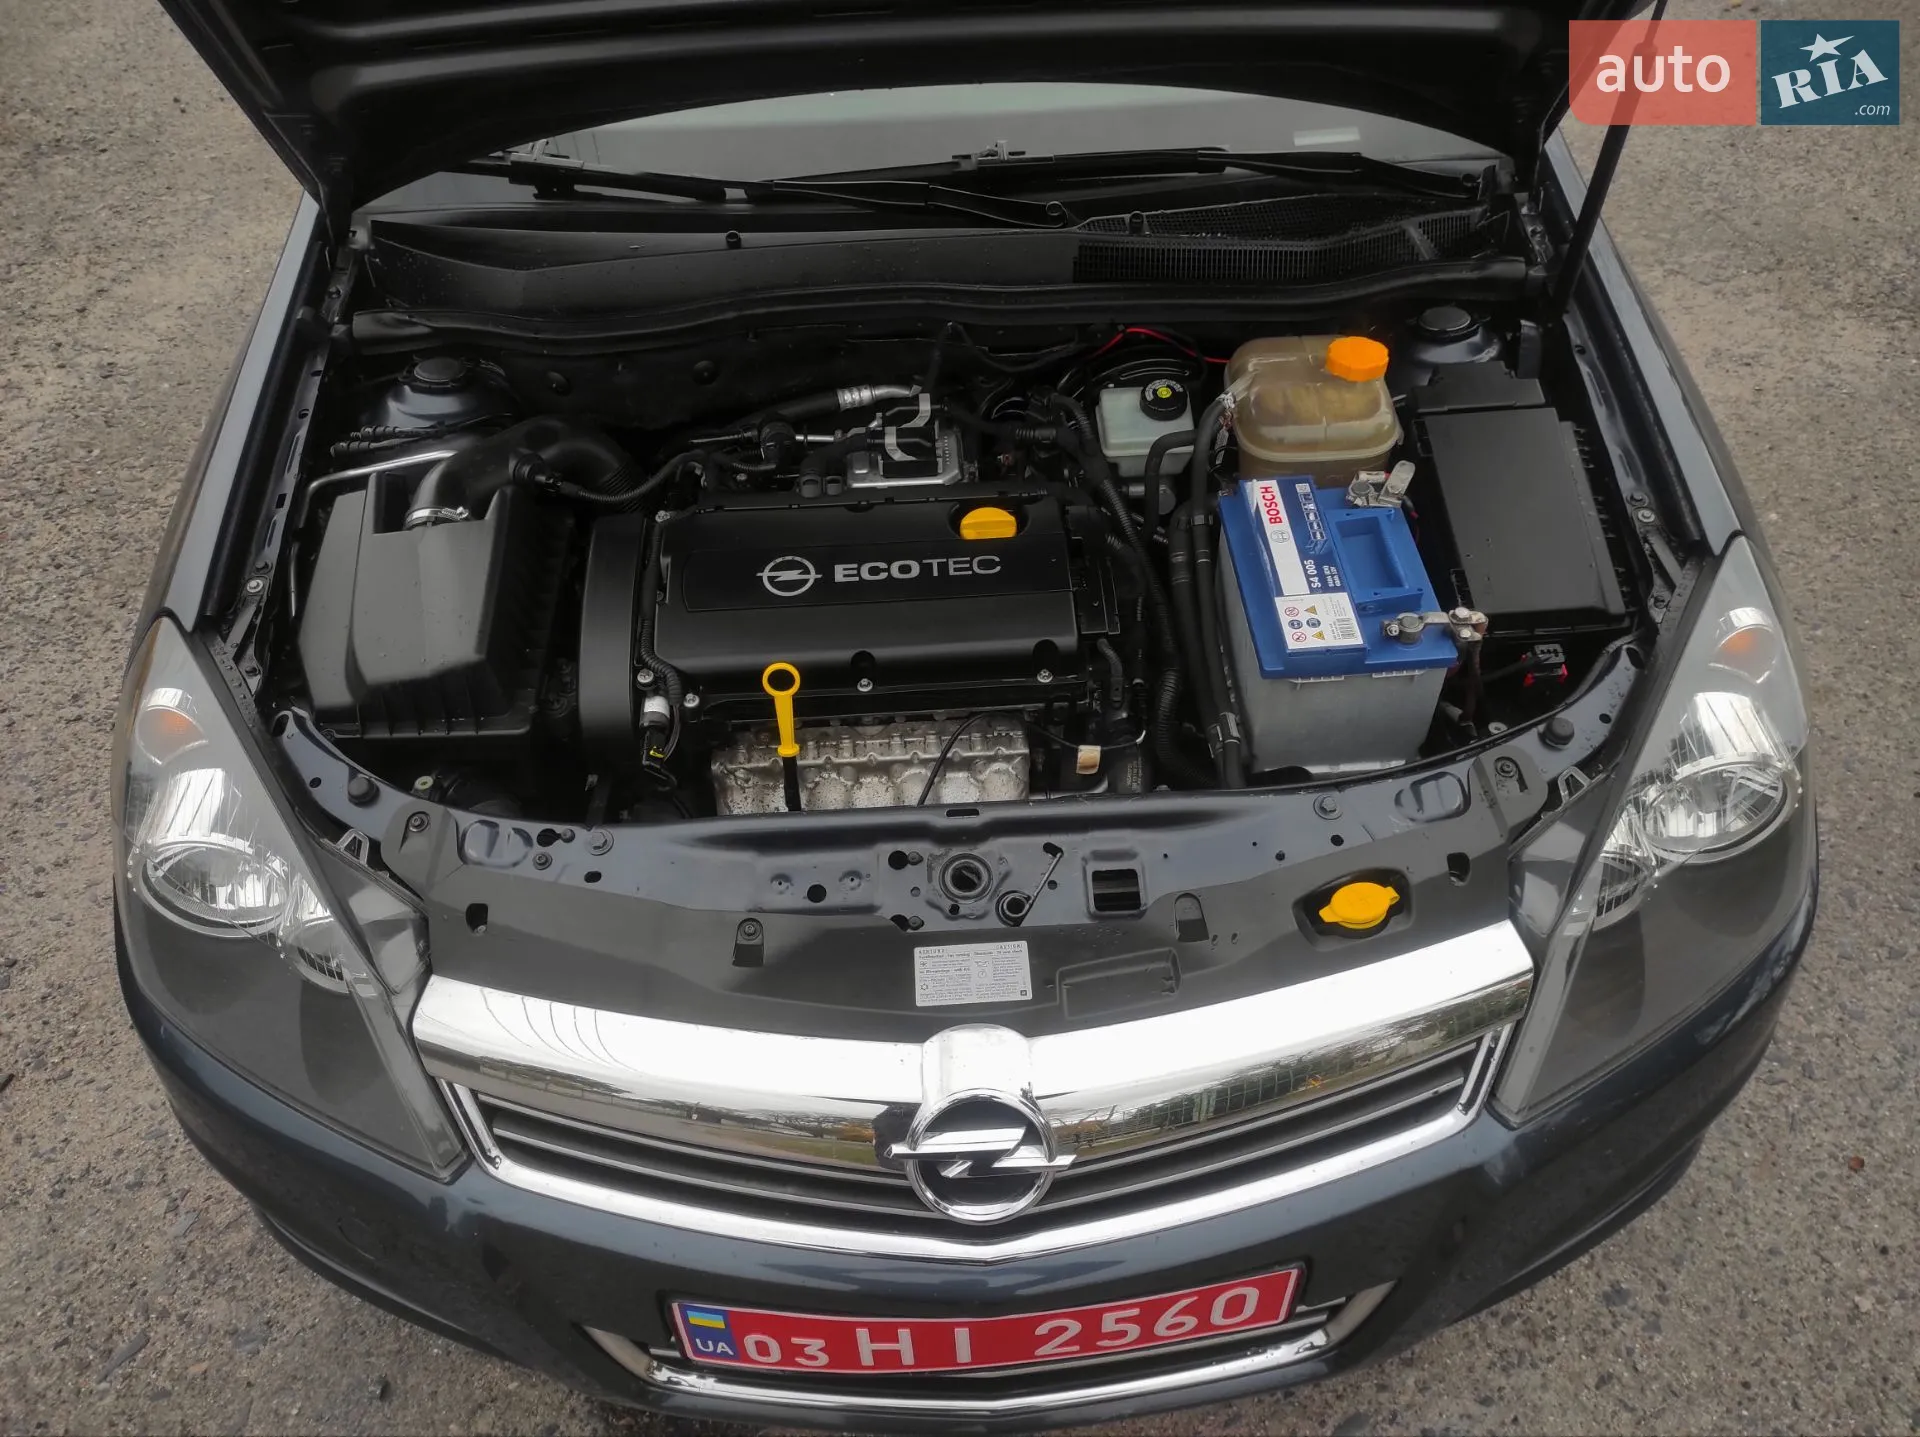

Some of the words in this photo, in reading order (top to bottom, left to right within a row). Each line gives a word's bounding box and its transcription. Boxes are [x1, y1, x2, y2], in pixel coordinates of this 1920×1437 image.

[1259, 486, 1283, 524] BOSCH
[834, 555, 1001, 583] ECOTEC
[1303, 559, 1317, 575] 005
[1308, 576, 1321, 588] S4
[743, 1334, 830, 1367] 03
[1035, 1286, 1260, 1355] 2560
[696, 1338, 734, 1355] UA
